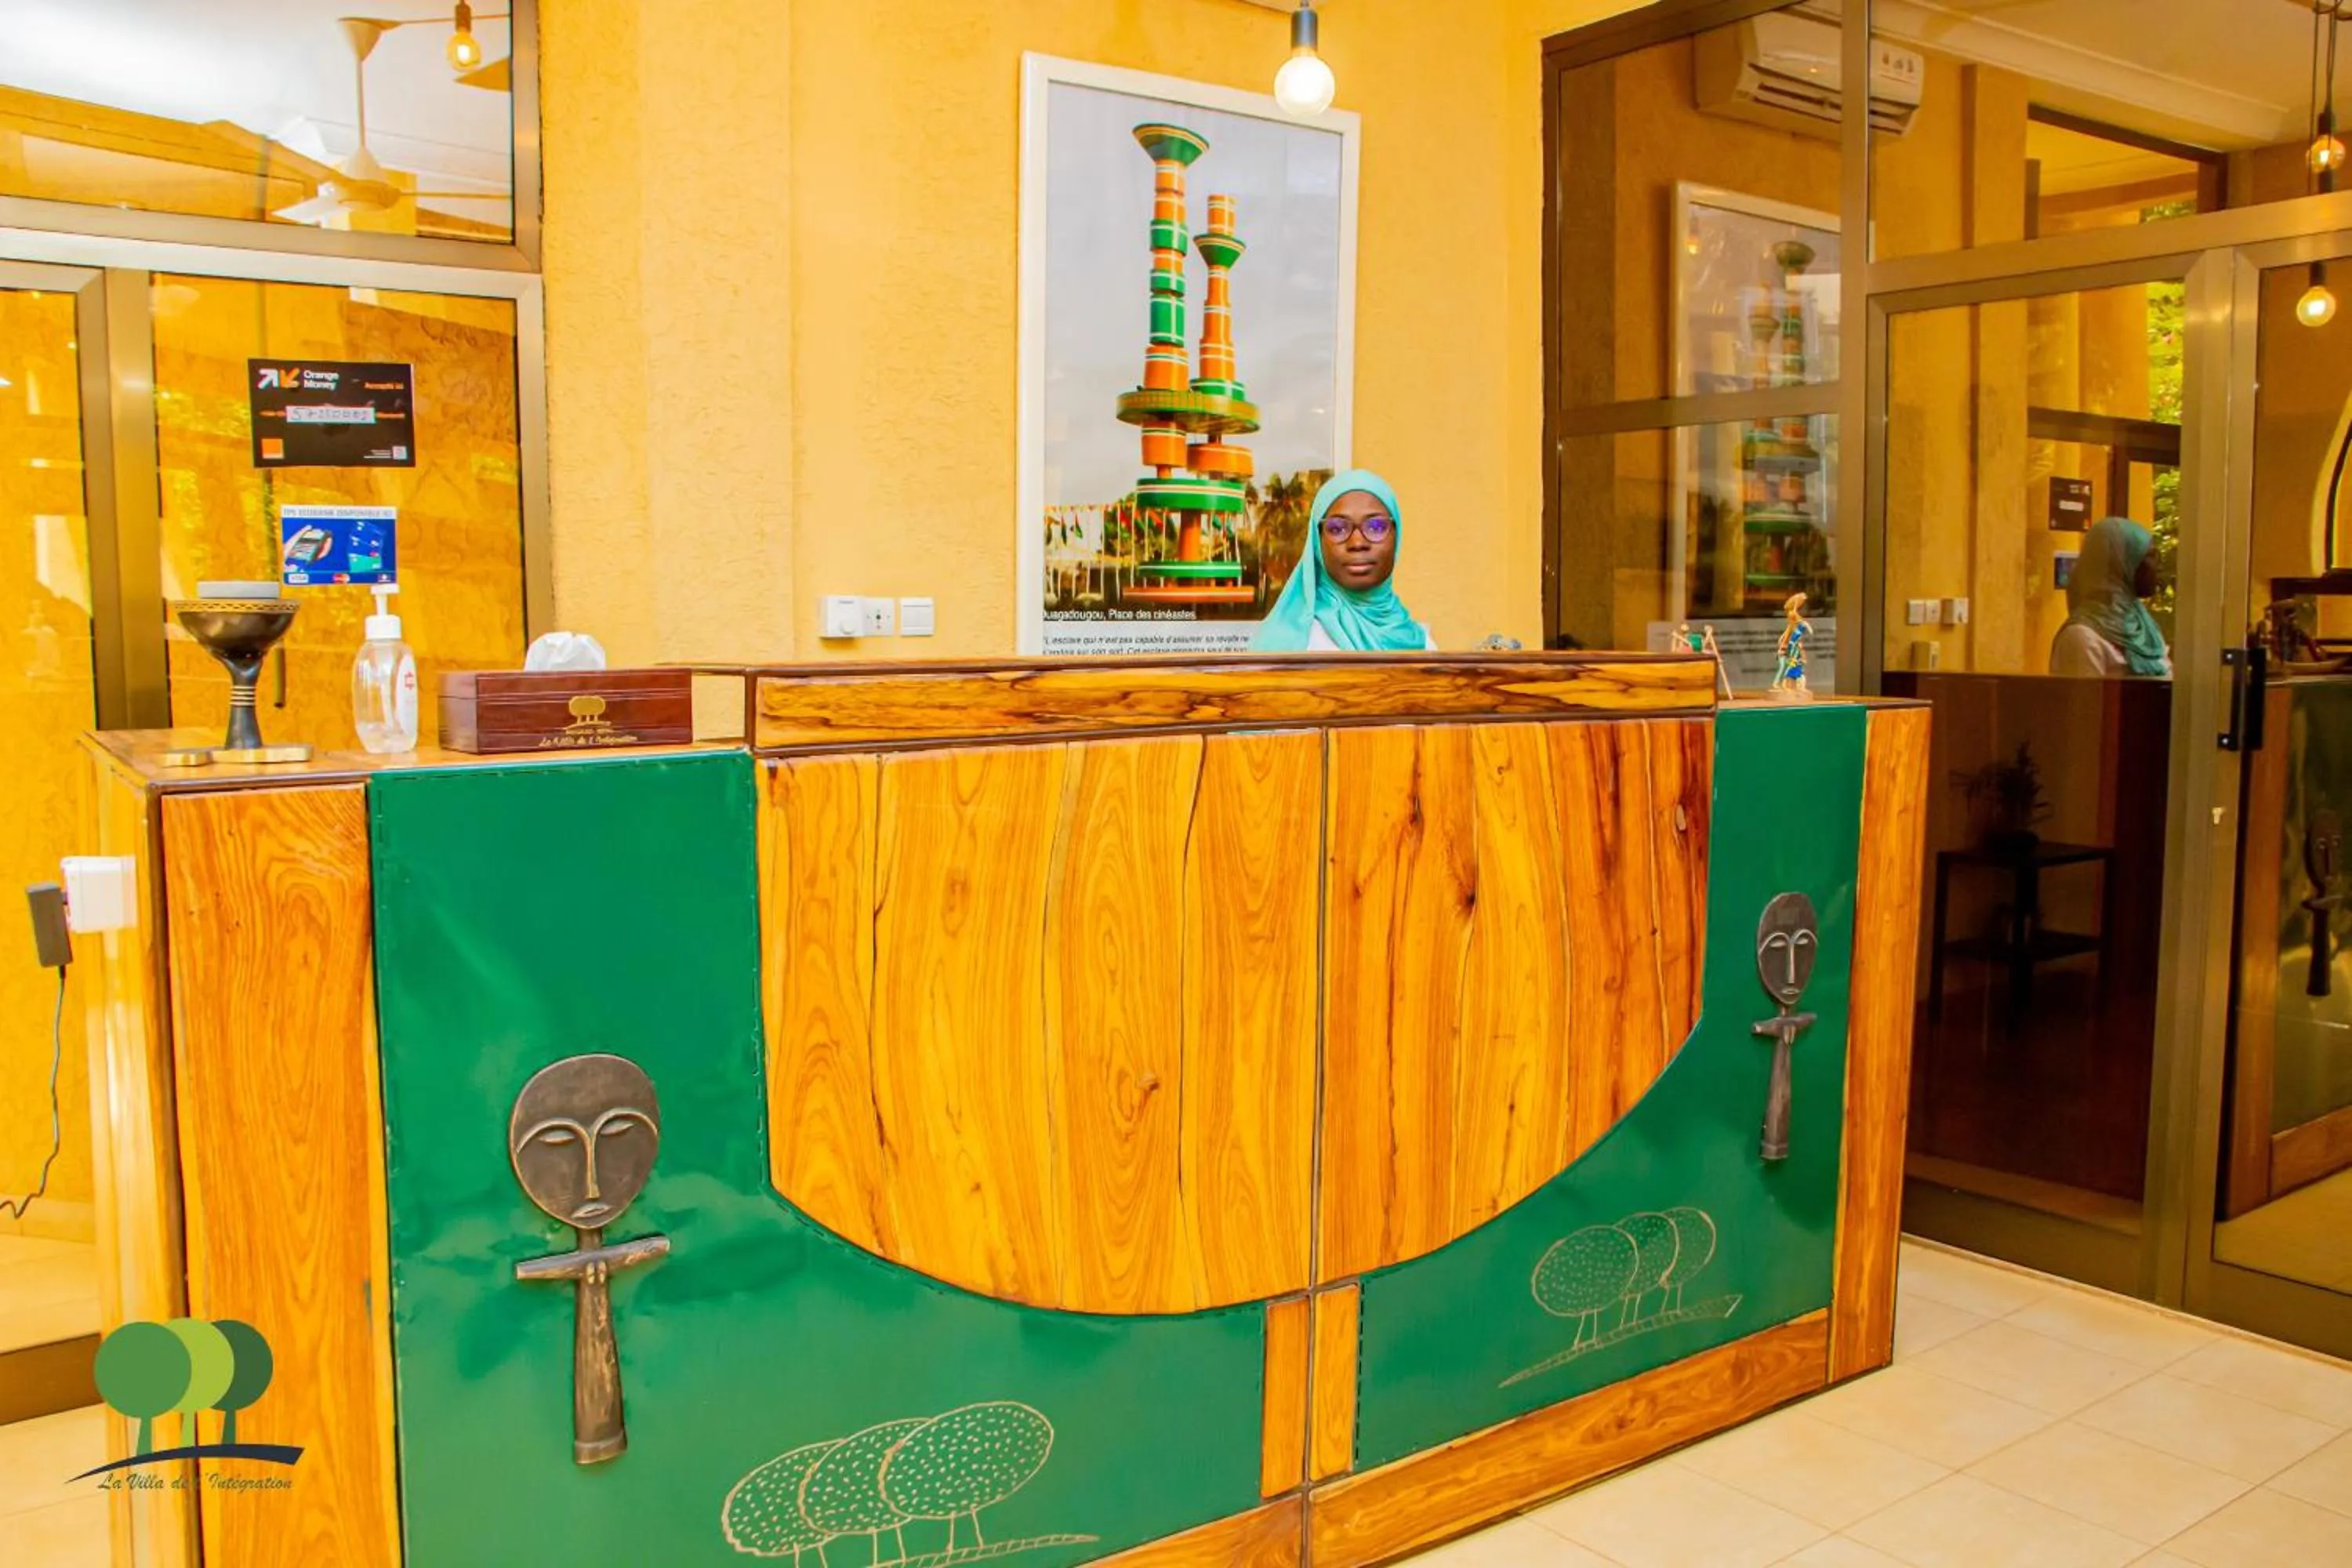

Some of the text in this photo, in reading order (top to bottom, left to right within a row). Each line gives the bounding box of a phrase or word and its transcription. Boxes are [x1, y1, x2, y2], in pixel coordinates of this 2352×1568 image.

[303, 370, 339, 382] Orange
[303, 379, 336, 391] Money
[1109, 609, 1134, 620] Place
[1135, 609, 1152, 620] des
[1153, 609, 1196, 620] cinéastes
